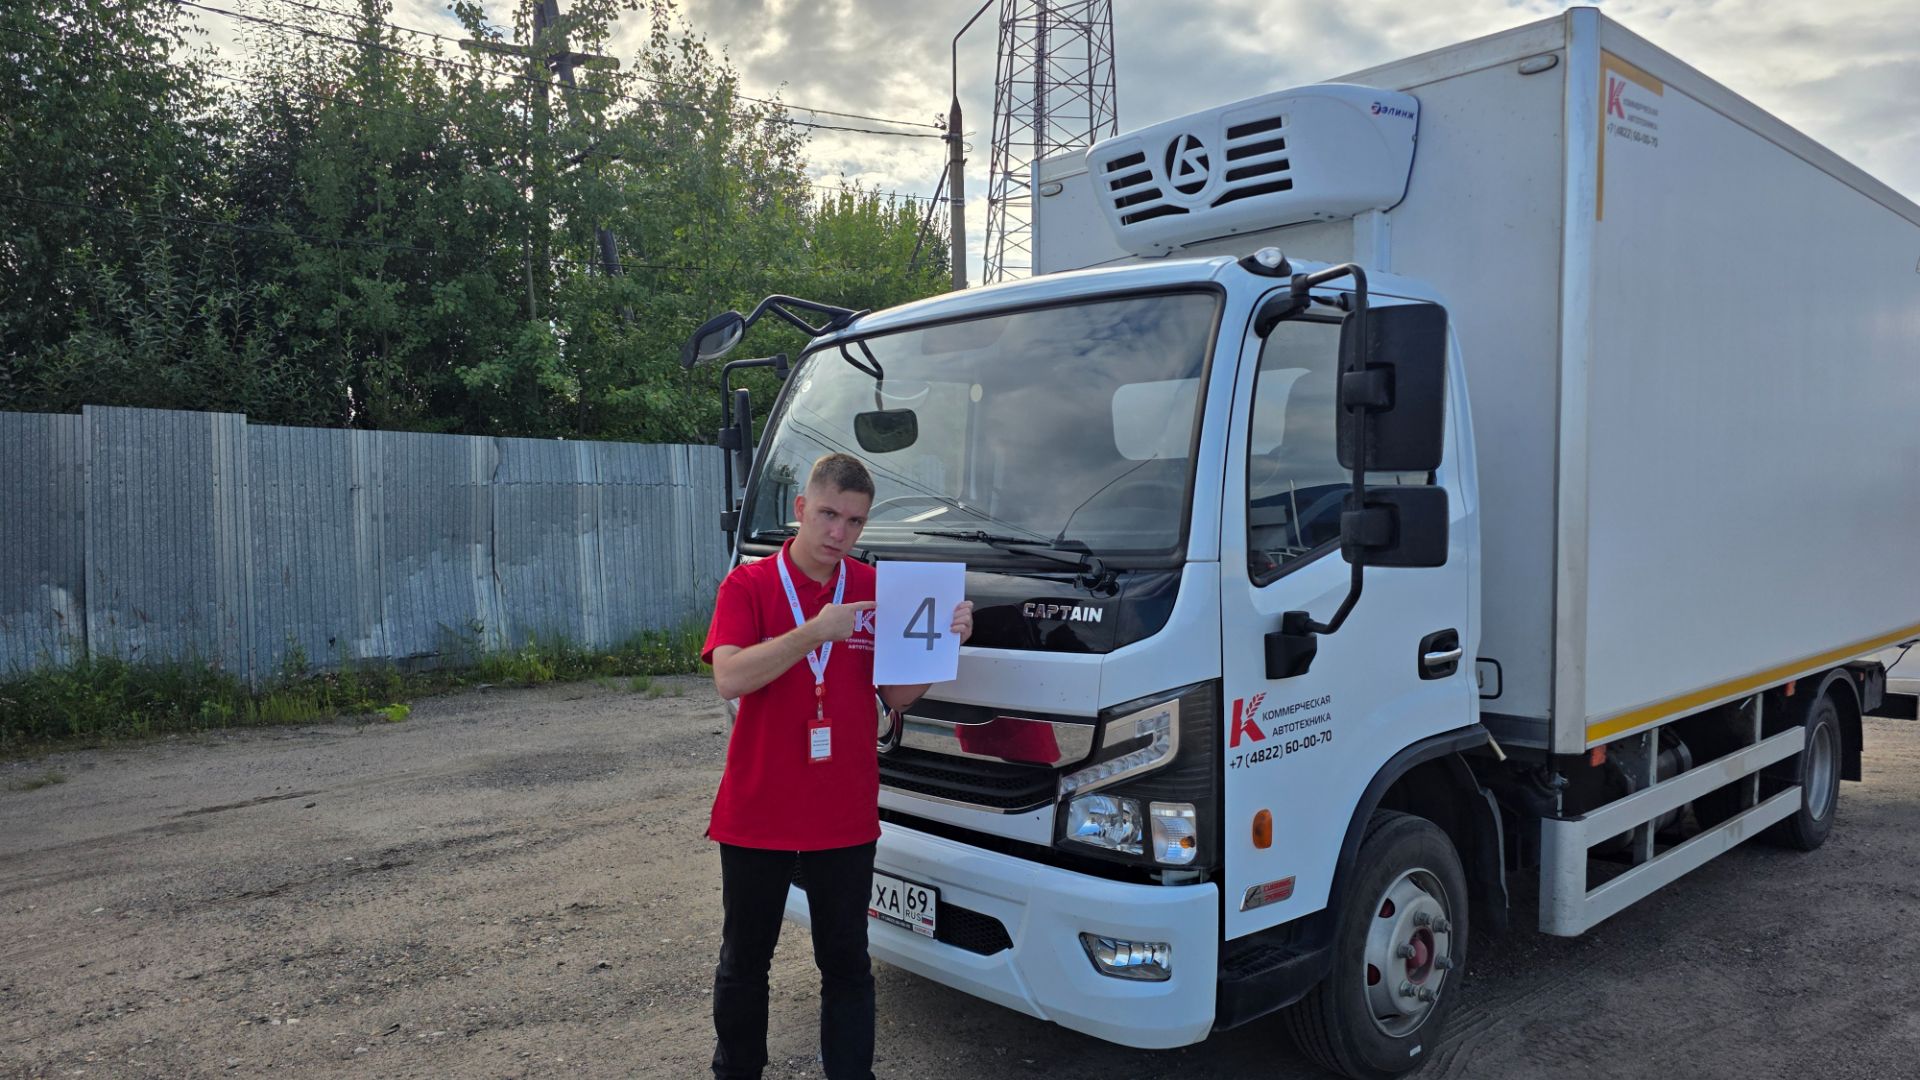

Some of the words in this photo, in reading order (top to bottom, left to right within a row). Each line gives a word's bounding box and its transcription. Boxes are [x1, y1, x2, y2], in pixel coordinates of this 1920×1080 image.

[903, 597, 942, 651] 4
[1023, 602, 1103, 623] CAPTAIN
[1262, 695, 1331, 721] КОММЕРЧЕСКАЯ
[1272, 712, 1331, 737] АВТОТЕХНИКА
[1230, 755, 1243, 769] +7
[1245, 744, 1284, 769] (4822)
[1285, 730, 1332, 754] 60-00-70
[907, 887, 928, 913] 69
[905, 909, 922, 922] RUS
